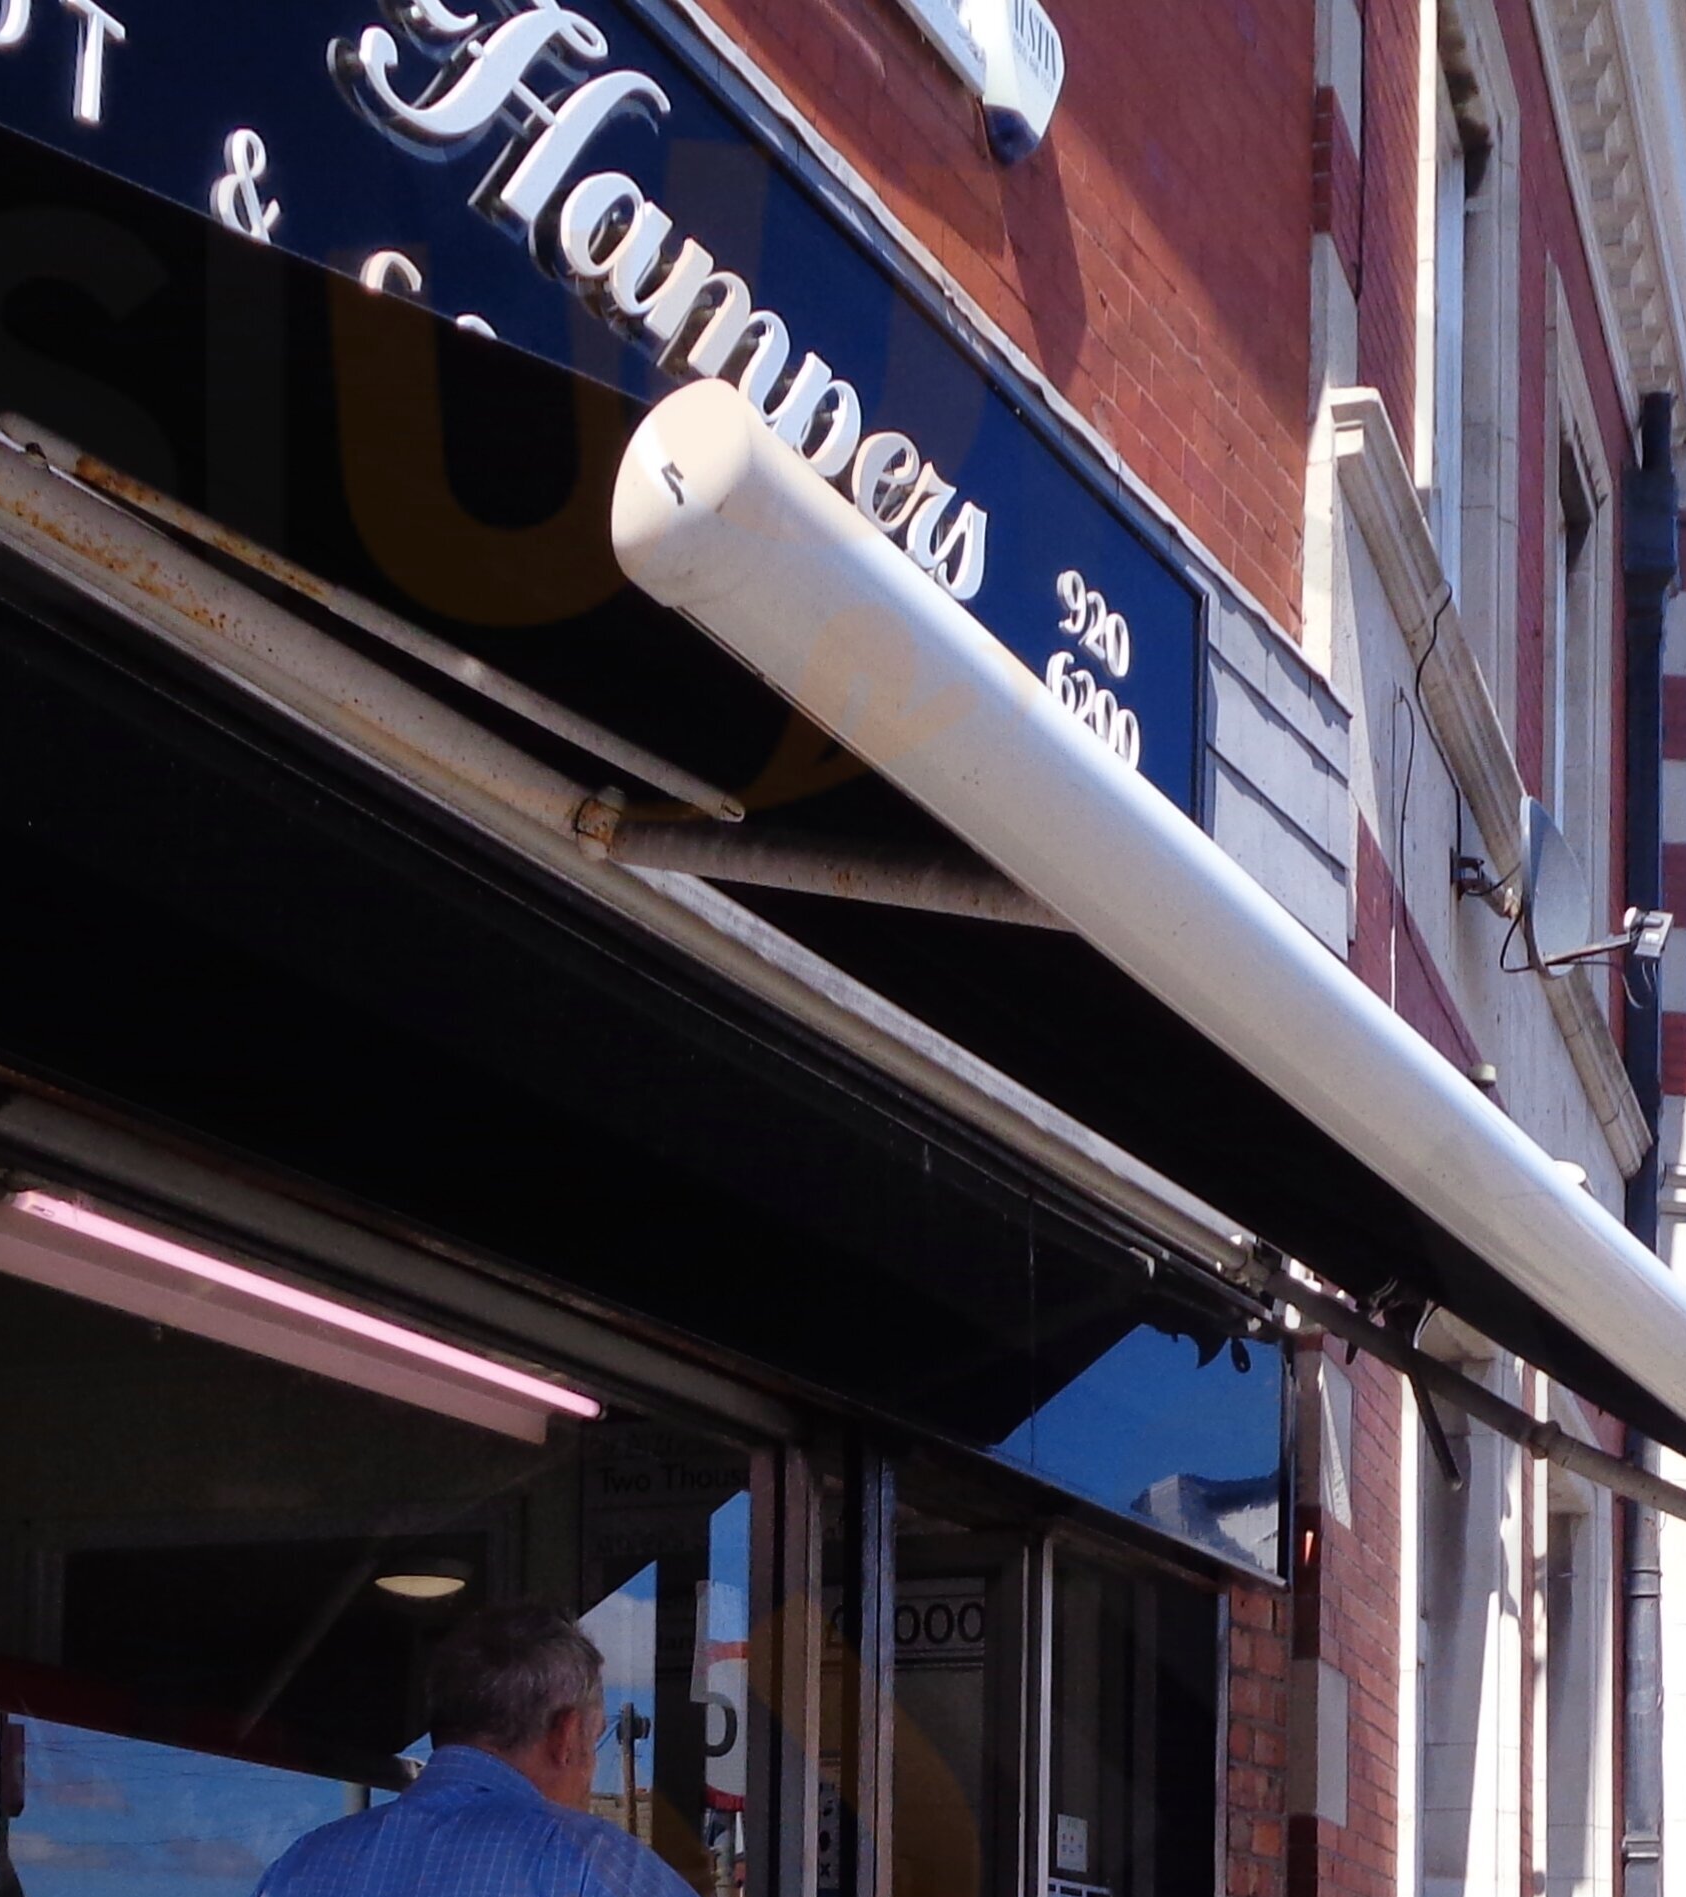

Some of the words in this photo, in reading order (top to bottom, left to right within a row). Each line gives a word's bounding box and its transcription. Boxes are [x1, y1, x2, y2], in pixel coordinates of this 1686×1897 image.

[329, 0, 987, 601] Hampers
[1056, 570, 1130, 678] 920
[1046, 651, 1141, 771] 6200
[599, 1466, 651, 1494] Two
